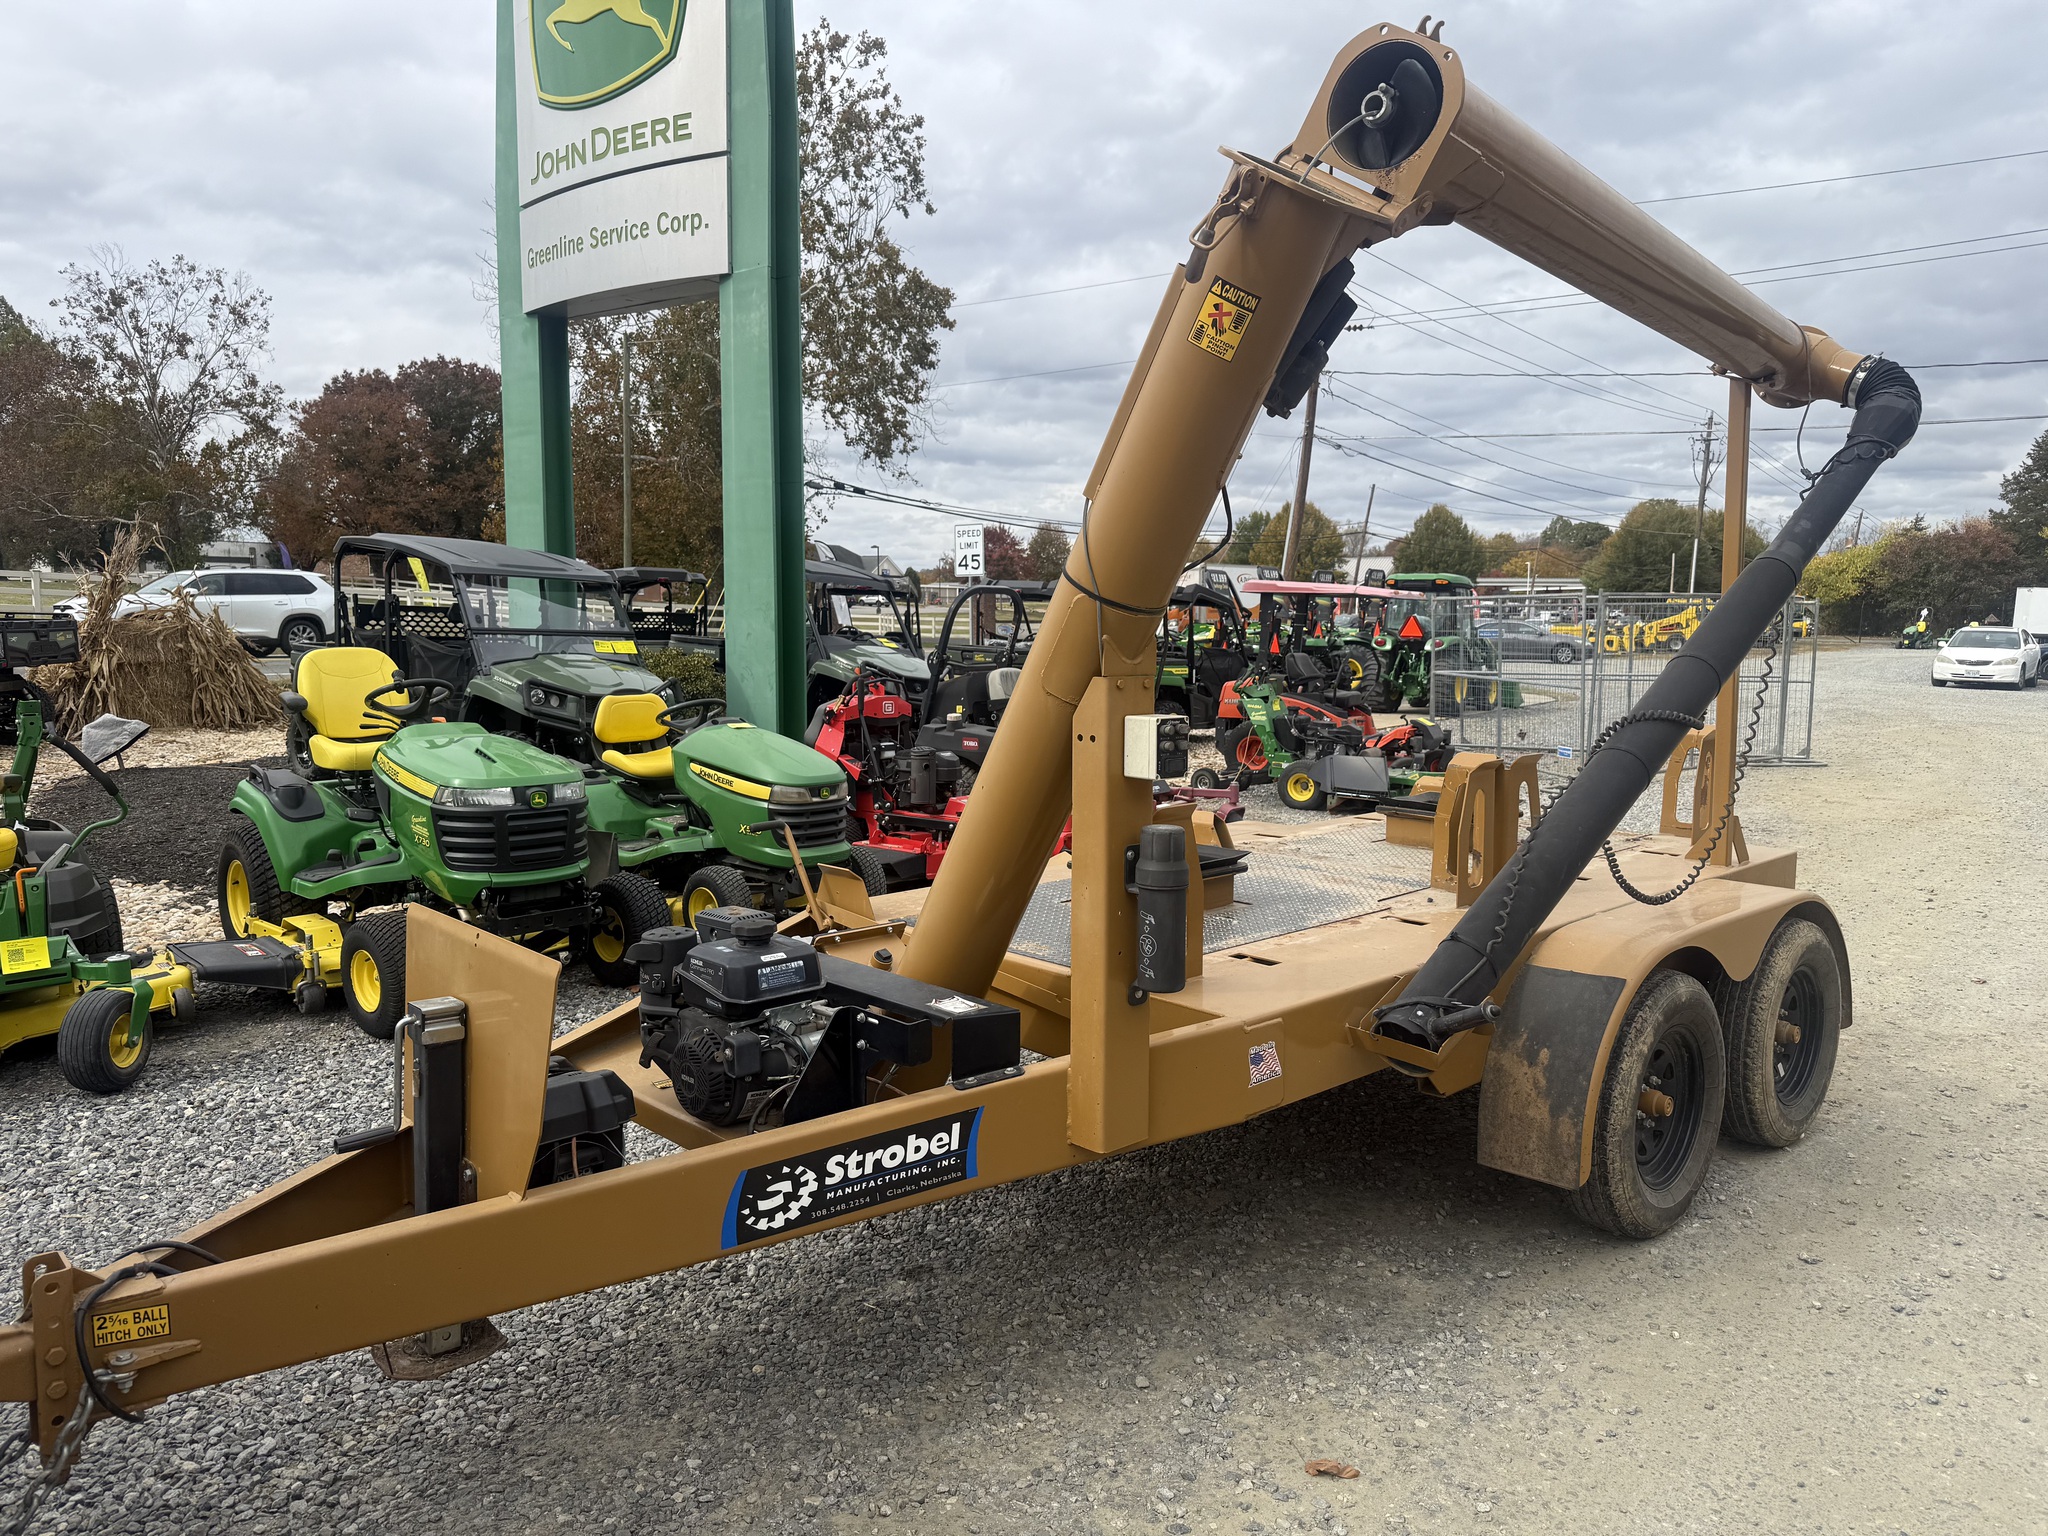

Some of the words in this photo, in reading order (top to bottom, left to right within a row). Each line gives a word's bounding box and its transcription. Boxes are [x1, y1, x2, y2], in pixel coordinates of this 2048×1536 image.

[531, 138, 587, 186] JOHN
[591, 112, 692, 162] DEERE
[527, 235, 584, 269] Greenline
[589, 219, 650, 250] Service
[656, 211, 709, 236] Corp.
[1221, 284, 1259, 311] CAUTION
[1206, 333, 1235, 350] CAUTION
[1206, 345, 1227, 357] POINT
[1207, 340, 1229, 353] PINCH
[957, 529, 982, 538] SPEED
[959, 541, 979, 550] LIMIT
[958, 554, 981, 571] 45
[698, 767, 713, 781] JOHN
[713, 773, 734, 787] DEERE
[825, 1122, 961, 1185] Strobel
[826, 1165, 932, 1200] MANUFACTURING,
[937, 1157, 961, 1169] INC.
[811, 1195, 870, 1219] 308.548.2254
[886, 1185, 918, 1197] Clarks,
[920, 1171, 962, 1187] Nebraska
[133, 1308, 166, 1324] BALL
[97, 1328, 131, 1344] HITCH
[137, 1323, 167, 1337] ONLY
